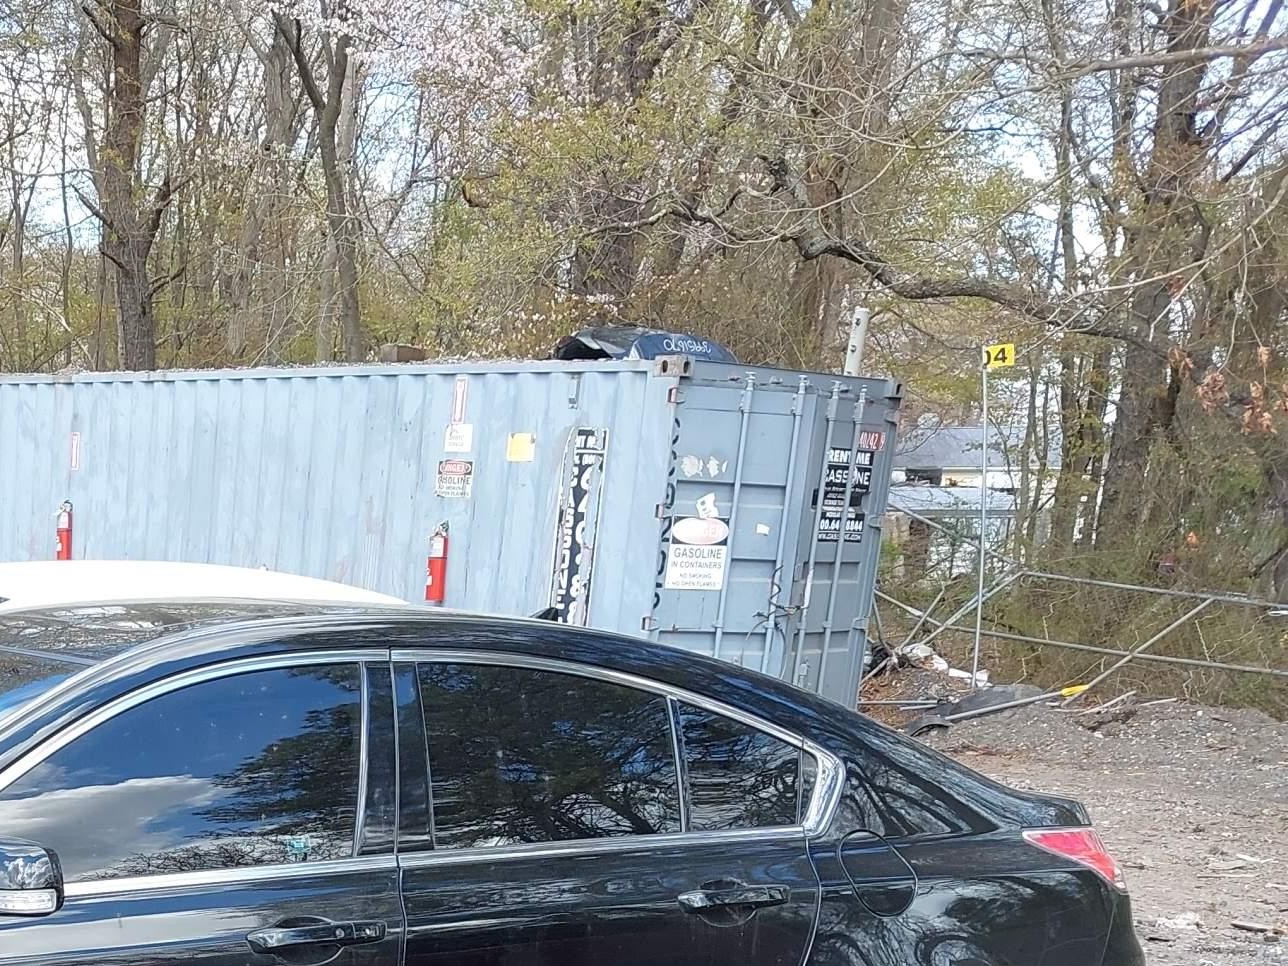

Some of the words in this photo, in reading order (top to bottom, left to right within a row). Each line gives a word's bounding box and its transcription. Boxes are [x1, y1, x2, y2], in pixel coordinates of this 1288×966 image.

[829, 450, 851, 463] RENT
[856, 453, 871, 465] ME
[825, 469, 870, 485] ASSNE
[674, 547, 723, 559] GASOLINE
[680, 560, 722, 568] CONTAINERS
